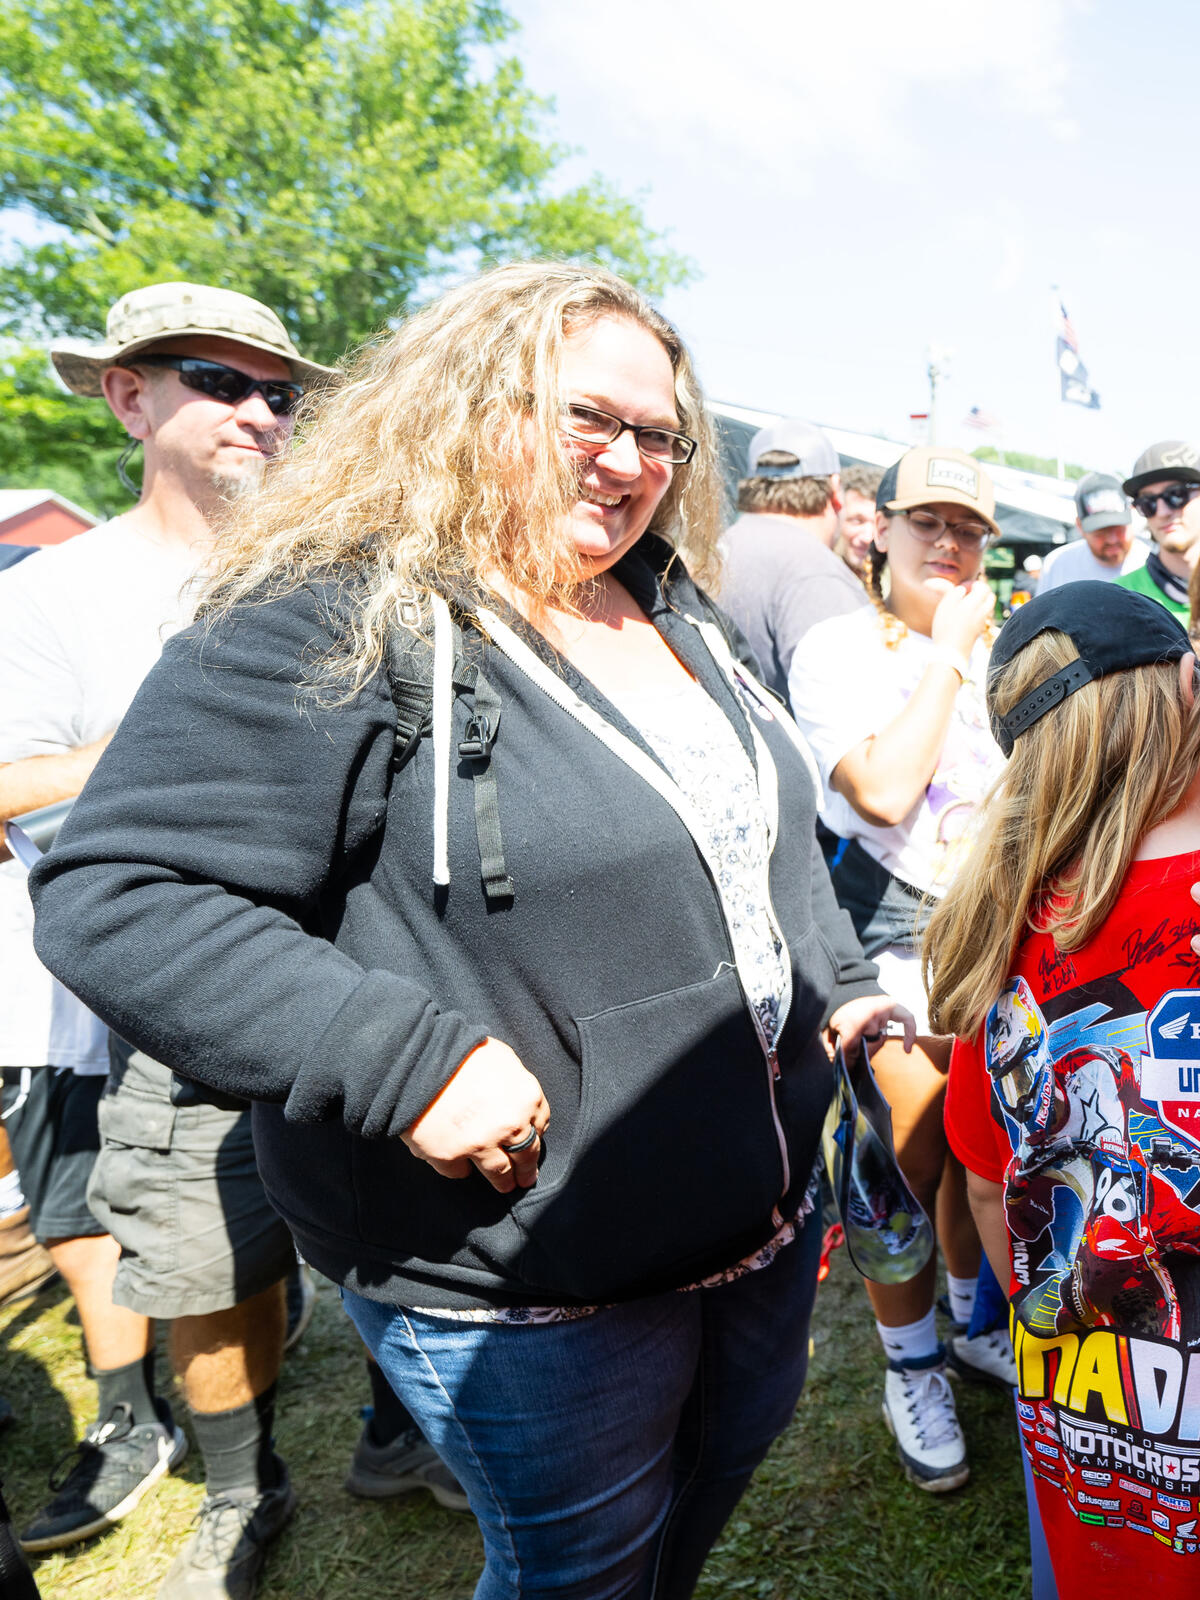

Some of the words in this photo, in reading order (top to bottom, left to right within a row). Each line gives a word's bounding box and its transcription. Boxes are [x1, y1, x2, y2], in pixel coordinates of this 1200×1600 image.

[1110, 1427, 1152, 1449] PRO
[1081, 1469, 1113, 1481] GEICO
[1157, 1494, 1191, 1507] PARTS
